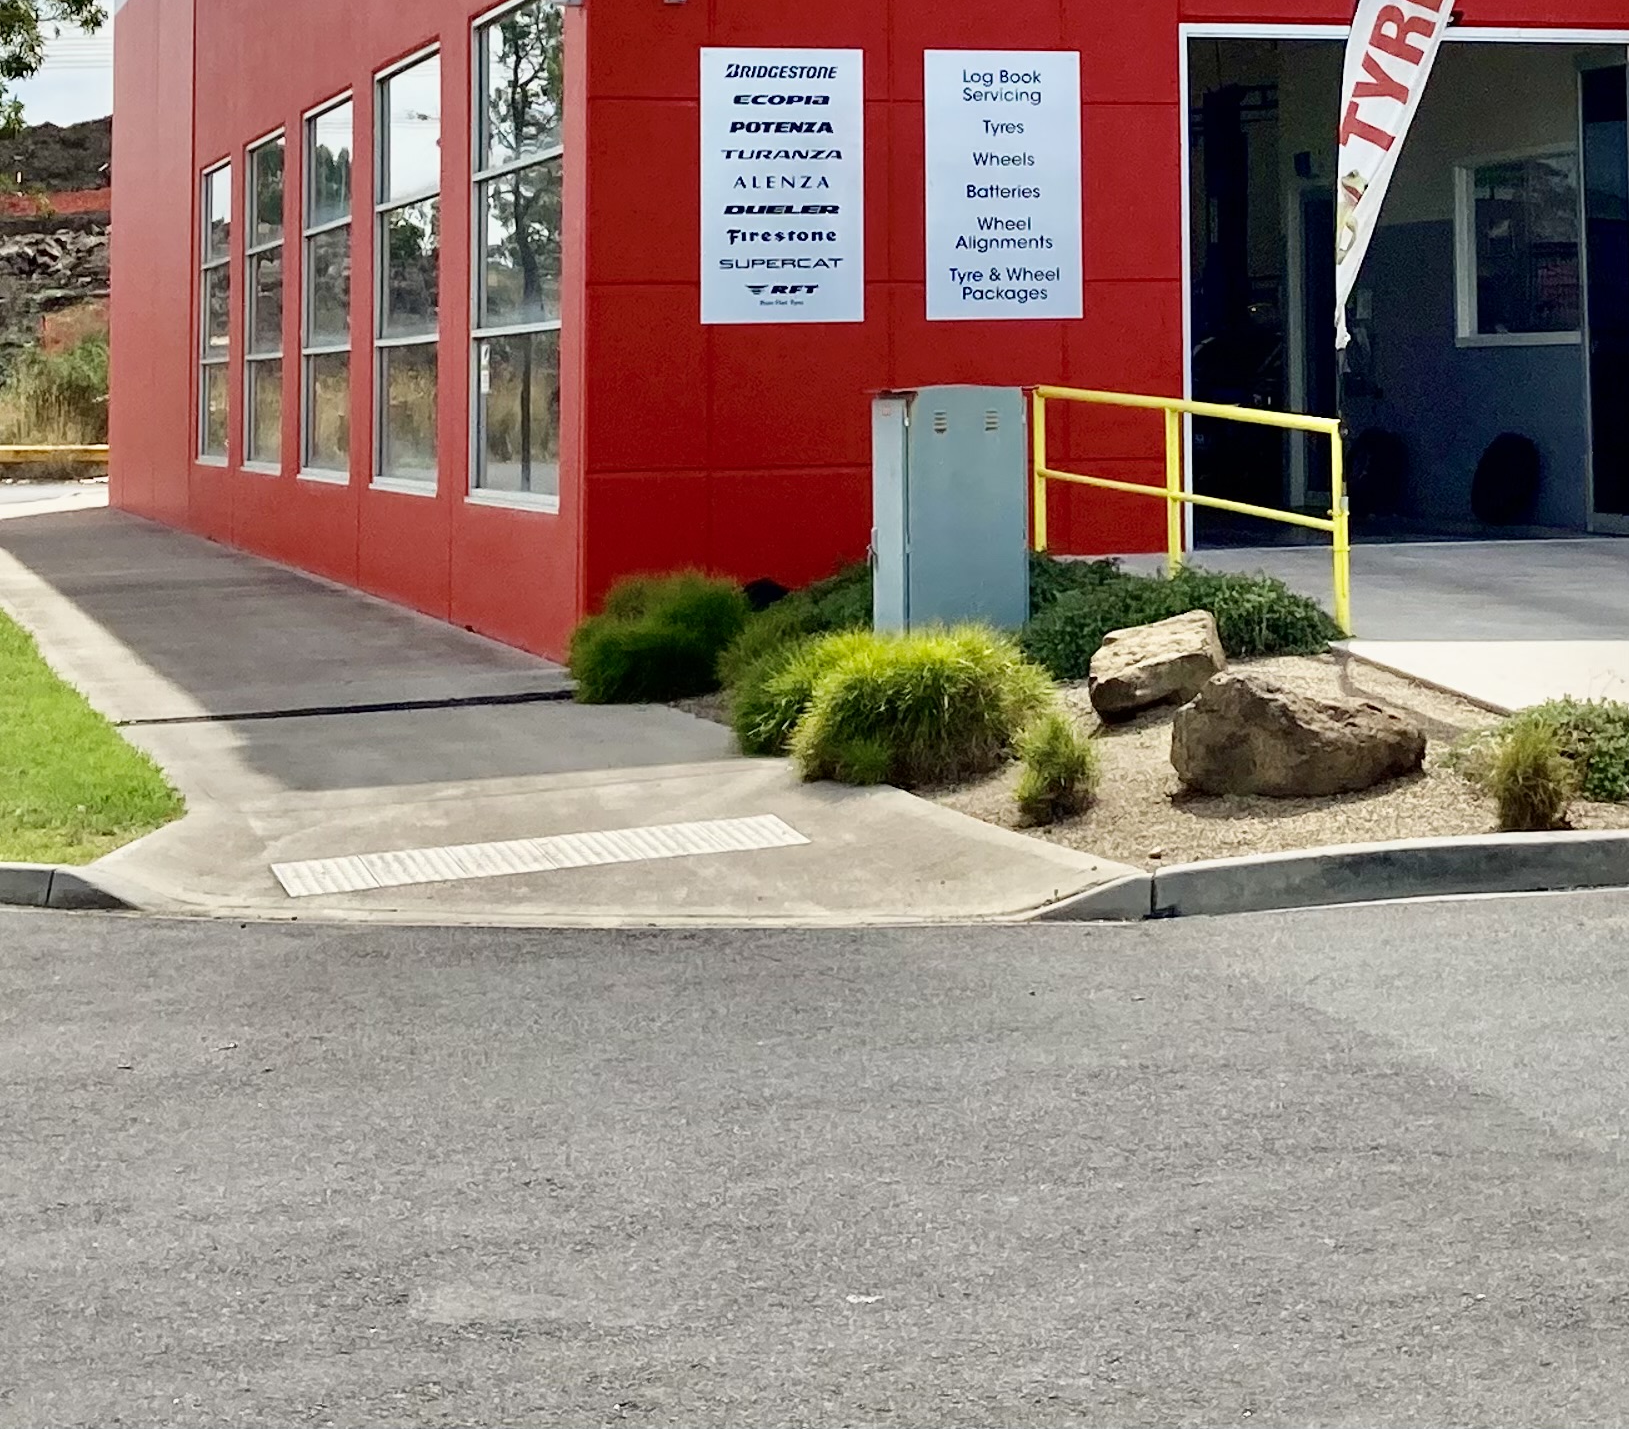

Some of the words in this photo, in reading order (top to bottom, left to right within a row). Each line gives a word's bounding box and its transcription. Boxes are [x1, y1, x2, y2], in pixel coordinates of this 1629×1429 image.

[725, 63, 839, 79] BRIDGESTONE
[962, 69, 994, 87] Log
[1000, 69, 1042, 84] Book
[962, 87, 1042, 106] Servicing
[729, 121, 834, 134] POTENZA
[982, 119, 1025, 137] Tyres
[720, 149, 843, 160] TURANZA
[972, 151, 1035, 167] Wheels
[733, 175, 830, 189] ALENZA
[966, 184, 1041, 199] Batteries
[723, 205, 840, 215] DUELER
[977, 216, 1032, 231] Wheel
[726, 228, 837, 245] Firestone
[955, 234, 1054, 253] Alignments
[719, 257, 844, 270] SUPERCAT
[949, 268, 984, 285] Tyre
[989, 267, 1001, 282] &
[1006, 267, 1061, 282] Wheel
[770, 284, 819, 294] RFT
[962, 286, 1048, 304] Packages
